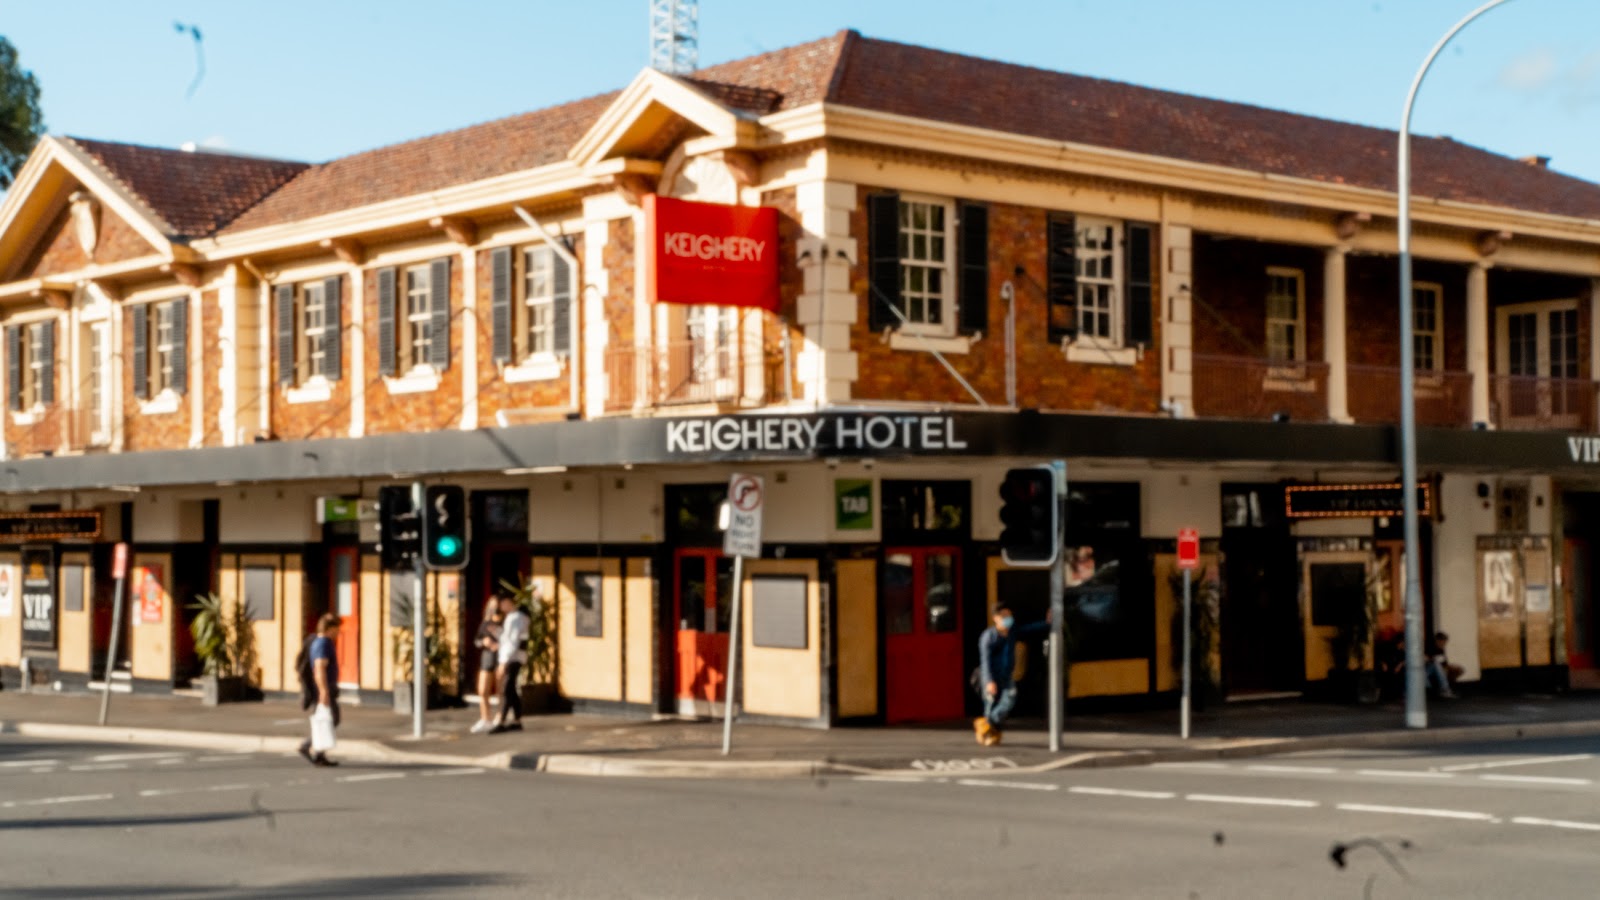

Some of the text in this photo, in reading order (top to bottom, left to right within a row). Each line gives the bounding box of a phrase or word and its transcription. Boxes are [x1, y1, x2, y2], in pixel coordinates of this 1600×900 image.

[664, 231, 765, 262] KEIGHERY
[667, 416, 967, 452] KEIGHERY HOTEL
[841, 497, 868, 513] TAB
[735, 514, 754, 528] NO
[23, 594, 52, 619] VIP
